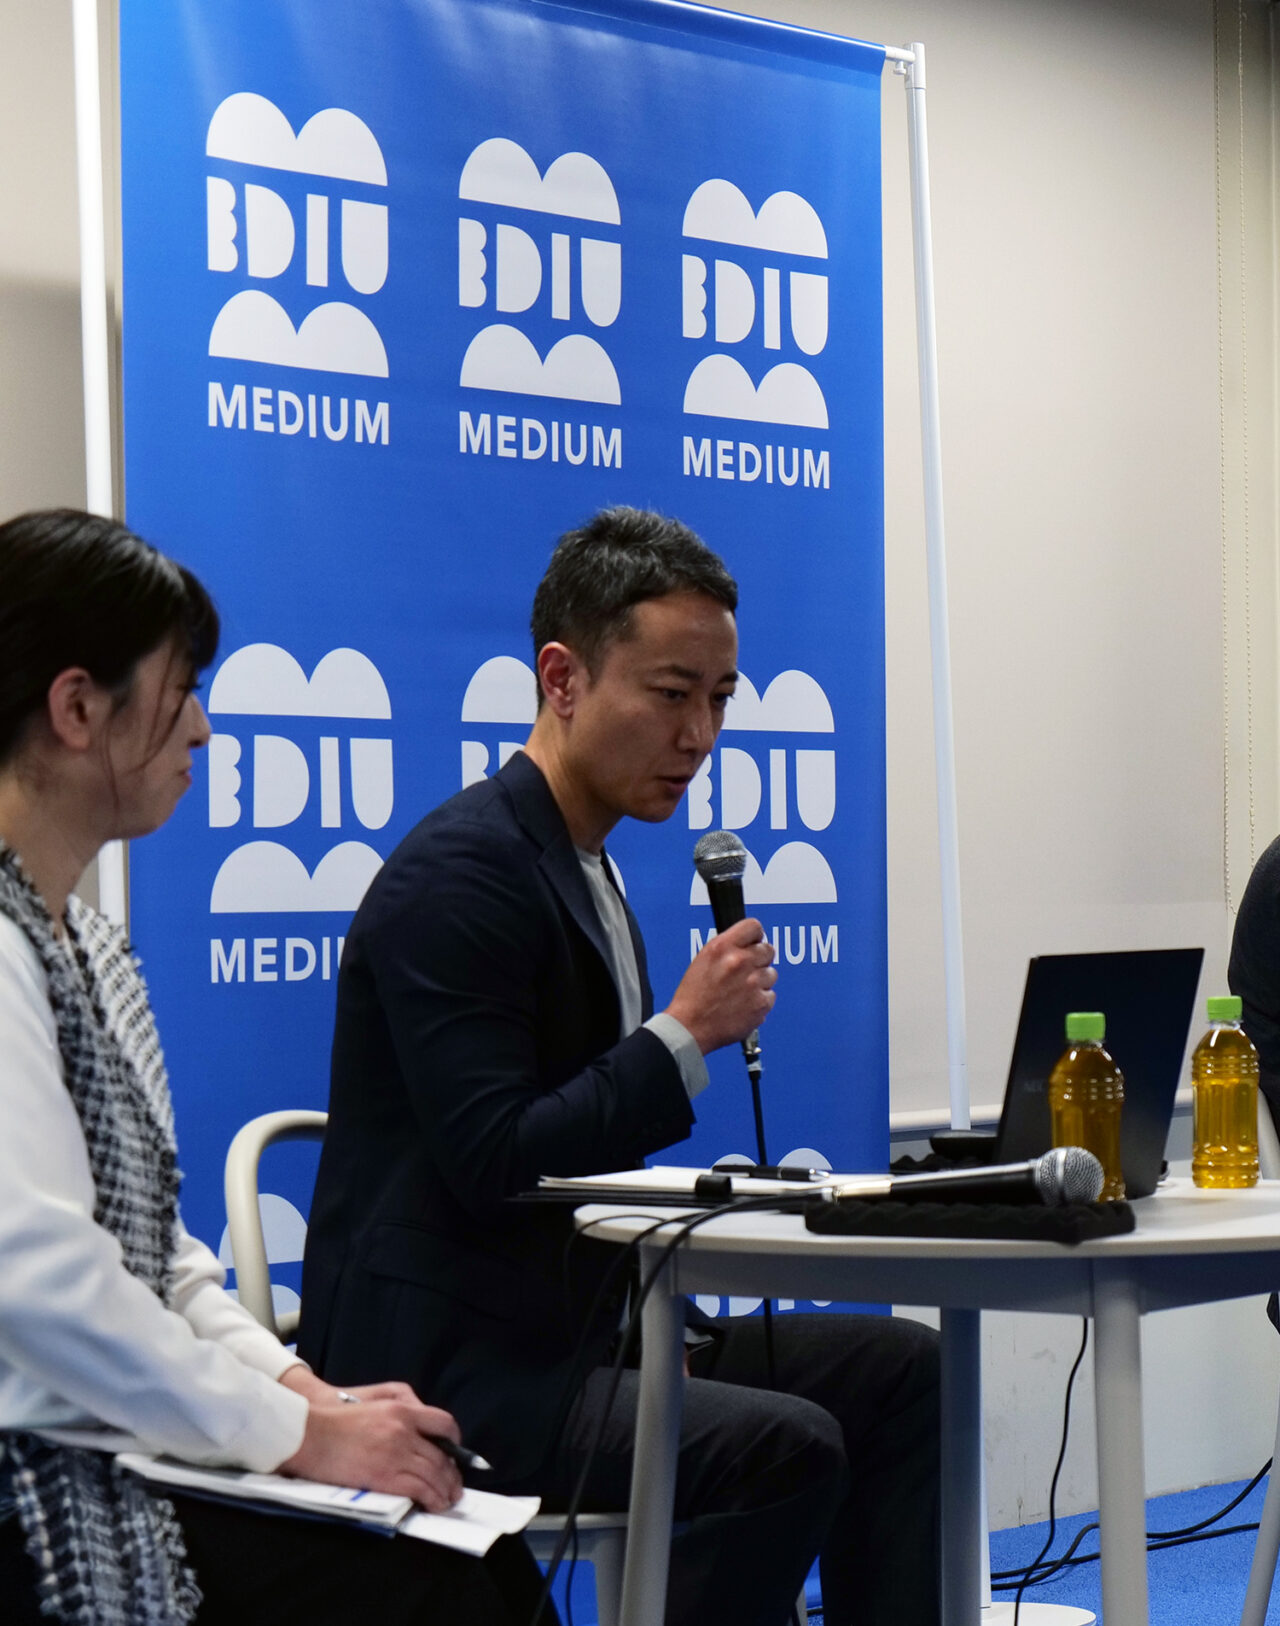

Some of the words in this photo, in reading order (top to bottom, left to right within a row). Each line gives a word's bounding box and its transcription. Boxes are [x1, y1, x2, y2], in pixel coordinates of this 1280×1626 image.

[208, 382, 389, 446] MEDIUM
[460, 411, 622, 468] MEDIUM
[684, 437, 830, 489] MEDIUM
[210, 937, 345, 983] MEDI
[690, 925, 838, 965] MIUM
